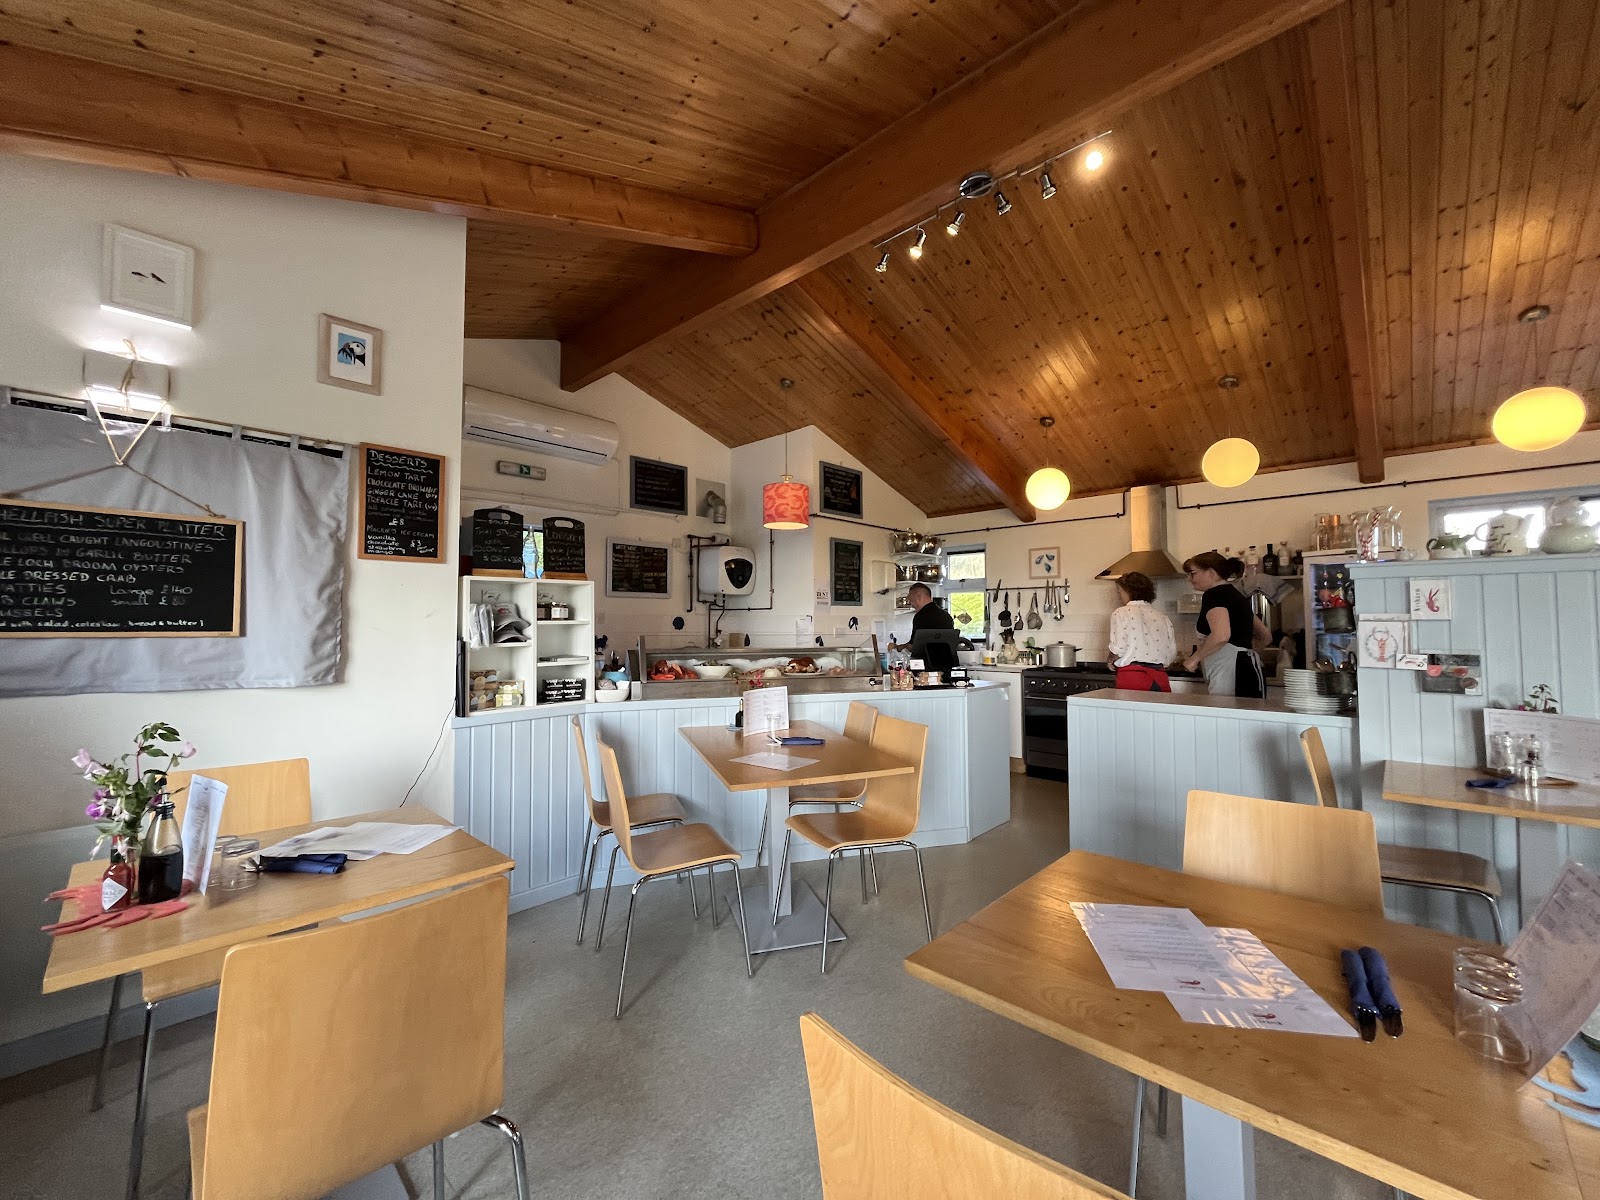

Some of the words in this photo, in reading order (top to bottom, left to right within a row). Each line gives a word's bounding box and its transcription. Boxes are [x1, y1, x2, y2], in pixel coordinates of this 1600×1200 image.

[369, 450, 427, 468] DESSERTS
[368, 466, 400, 477] LEMON
[404, 473, 426, 482] TART
[367, 478, 406, 490] CHOCOLATE
[367, 488, 395, 496] GINGER
[397, 492, 419, 500] CAKE
[367, 495, 399, 505] TREACLE
[403, 500, 422, 509] TART
[94, 515, 146, 530] SUPER
[59, 534, 109, 545] CAUGHT
[115, 537, 214, 552] LANGOUSTINES
[76, 548, 125, 559] GARLIC
[133, 552, 192, 564] BUTTER
[17, 558, 54, 568] LOCH
[122, 563, 184, 574] OYSTERS
[22, 571, 90, 582] DRESSED
[96, 573, 136, 583] CRAB
[22, 597, 76, 607] CLAWS
